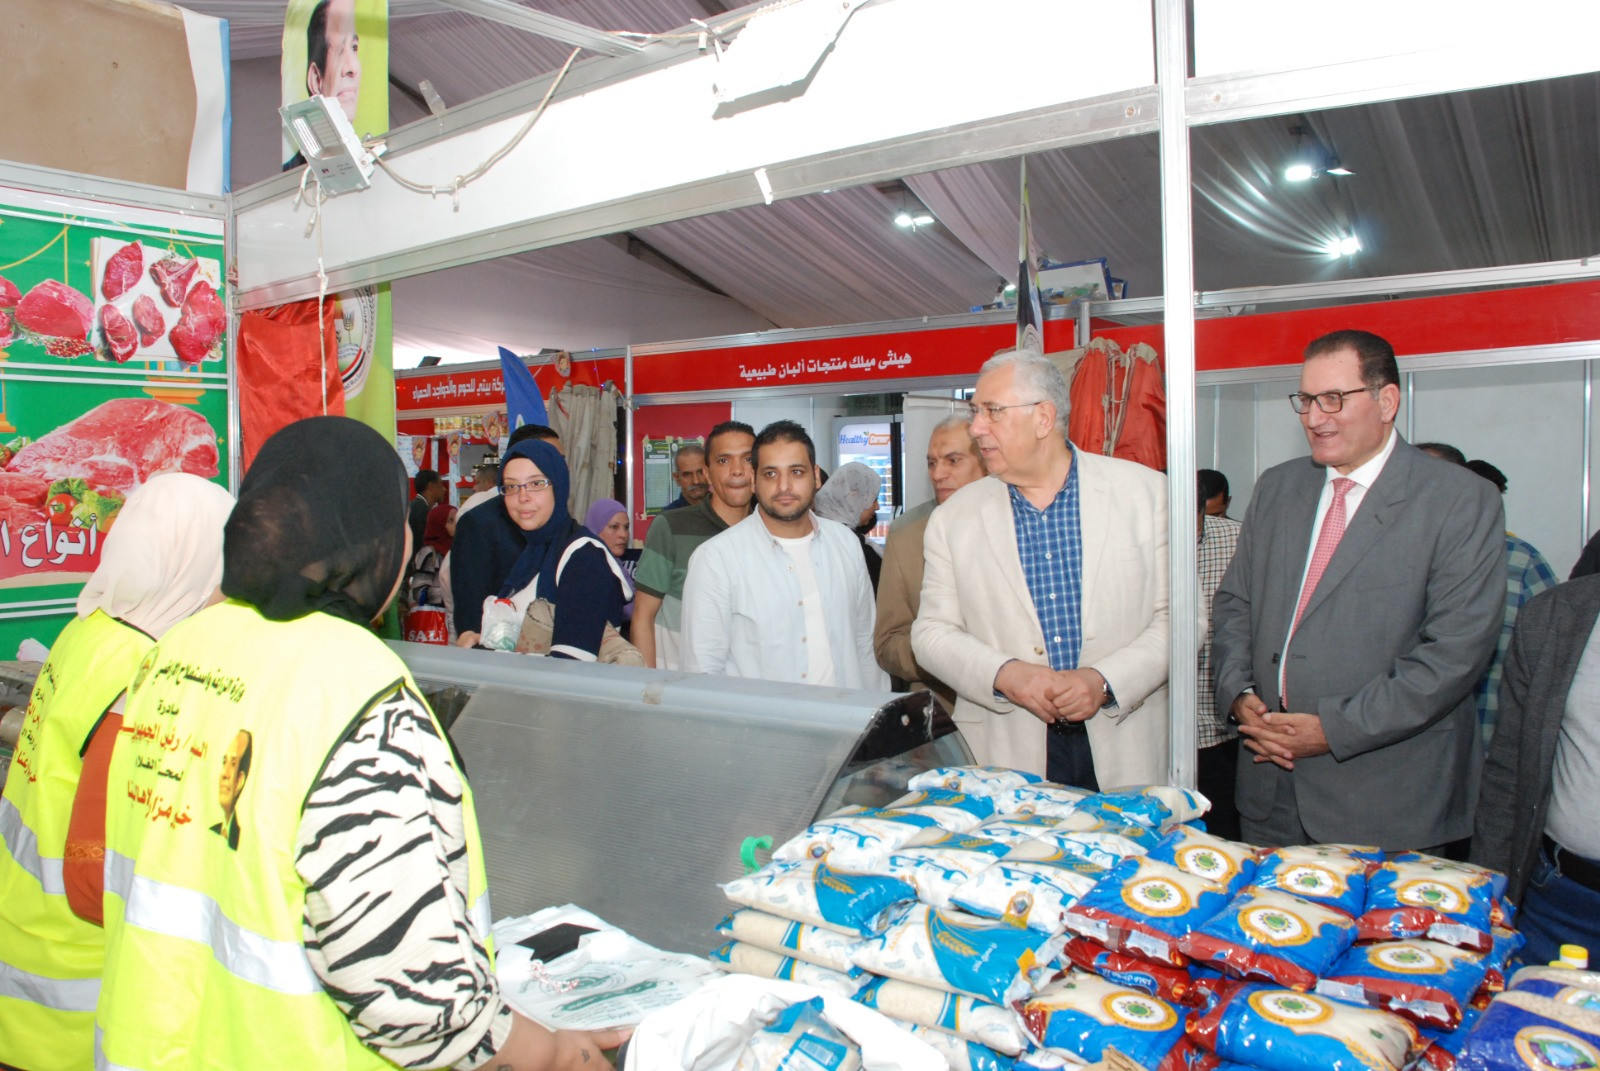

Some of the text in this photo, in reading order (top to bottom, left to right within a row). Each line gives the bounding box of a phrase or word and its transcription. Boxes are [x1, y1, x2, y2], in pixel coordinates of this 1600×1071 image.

[738, 363, 777, 382] طبيعية
[778, 358, 806, 379] ألبان
[807, 357, 847, 375] منتجات
[849, 355, 876, 372] ميلك
[839, 434, 868, 446] Healthy
[20, 513, 97, 568] أنواع
